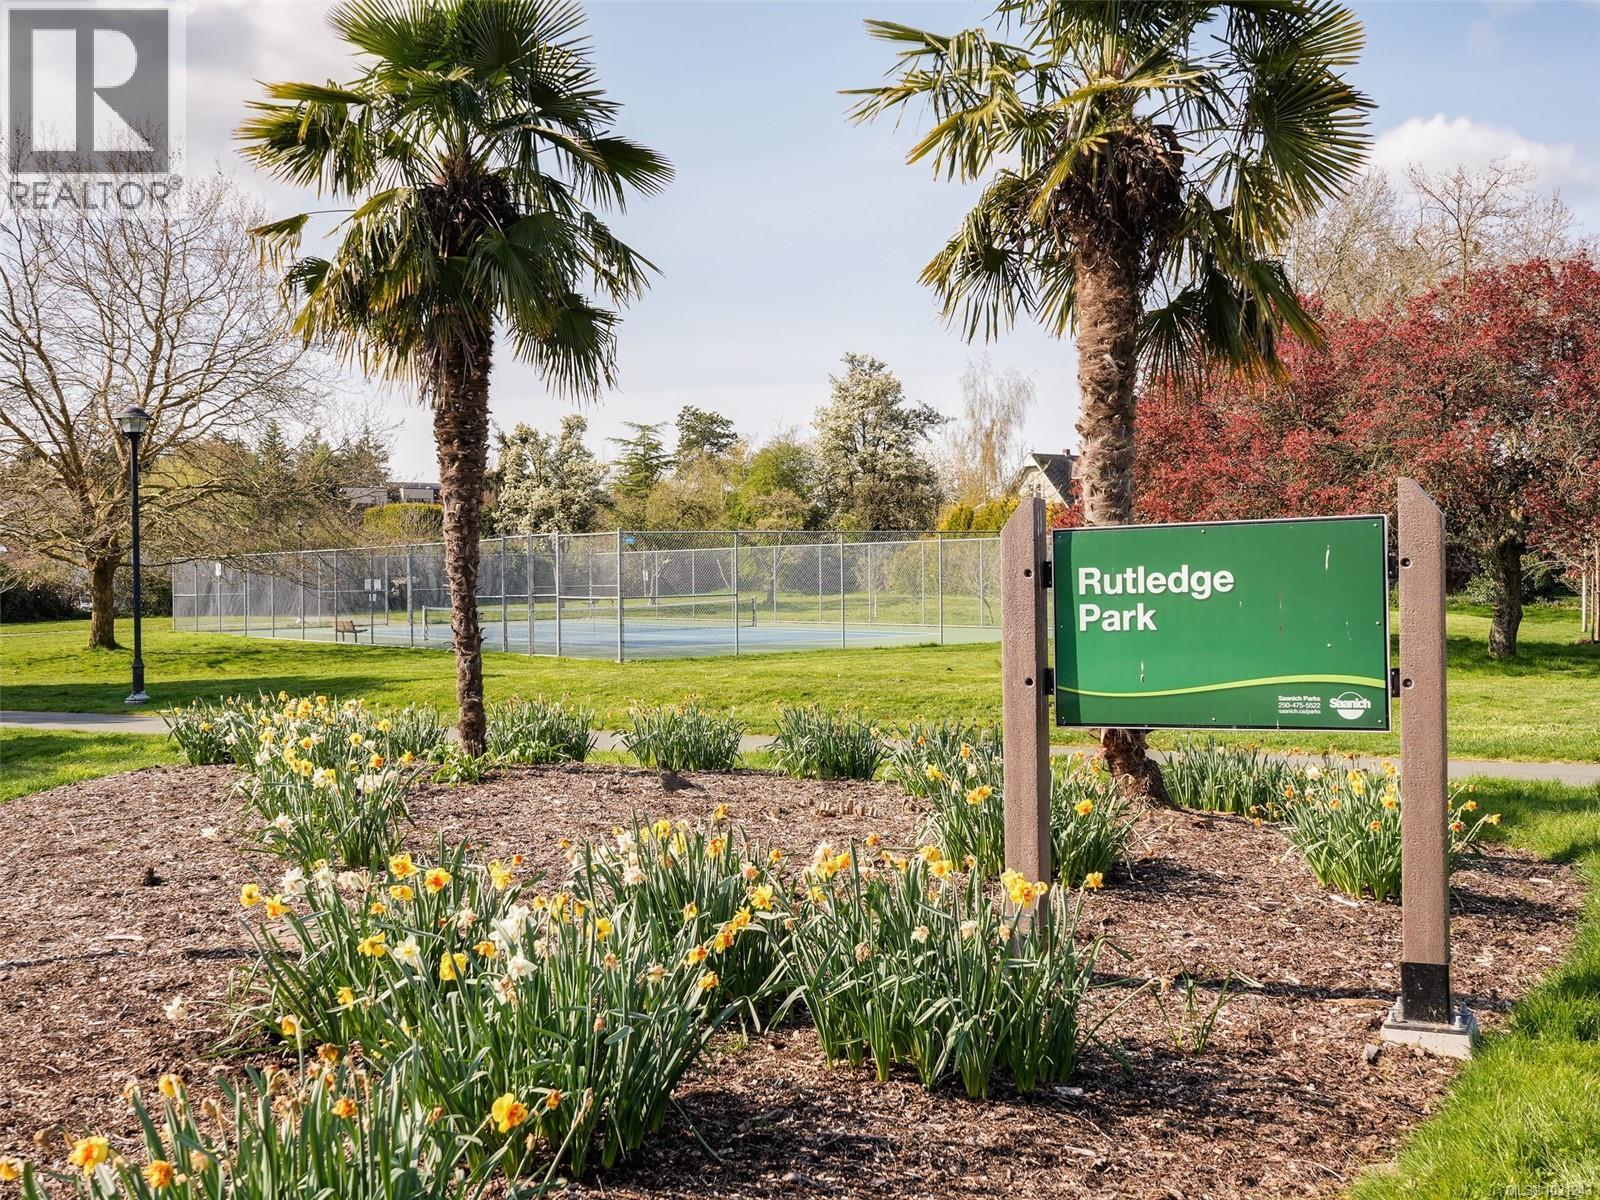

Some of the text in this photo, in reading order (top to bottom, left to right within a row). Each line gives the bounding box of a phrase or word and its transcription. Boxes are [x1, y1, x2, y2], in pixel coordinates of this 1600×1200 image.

[1078, 564, 1235, 600] Rutledge
[1079, 603, 1157, 632] Park
[1329, 697, 1371, 709] Saanich
